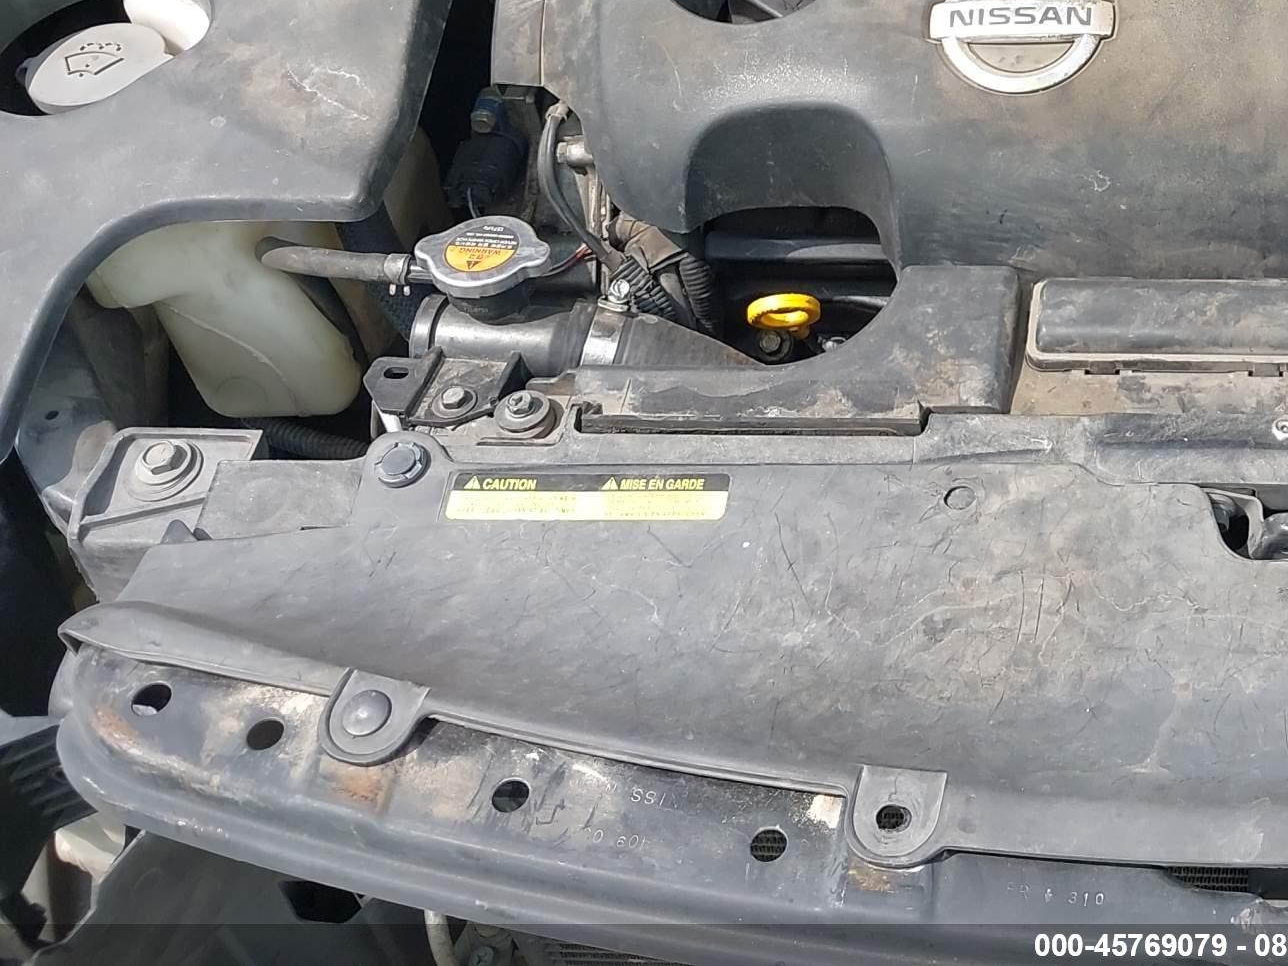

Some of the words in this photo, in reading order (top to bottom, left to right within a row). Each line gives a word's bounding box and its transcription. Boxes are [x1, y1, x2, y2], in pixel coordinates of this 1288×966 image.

[949, 6, 1092, 28] NISSAN
[460, 247, 501, 256] WARNING
[482, 478, 537, 490] CAUTION
[619, 478, 646, 490] MISE
[648, 478, 664, 490] EN
[666, 478, 705, 490] GARDE
[1068, 891, 1105, 907] 310
